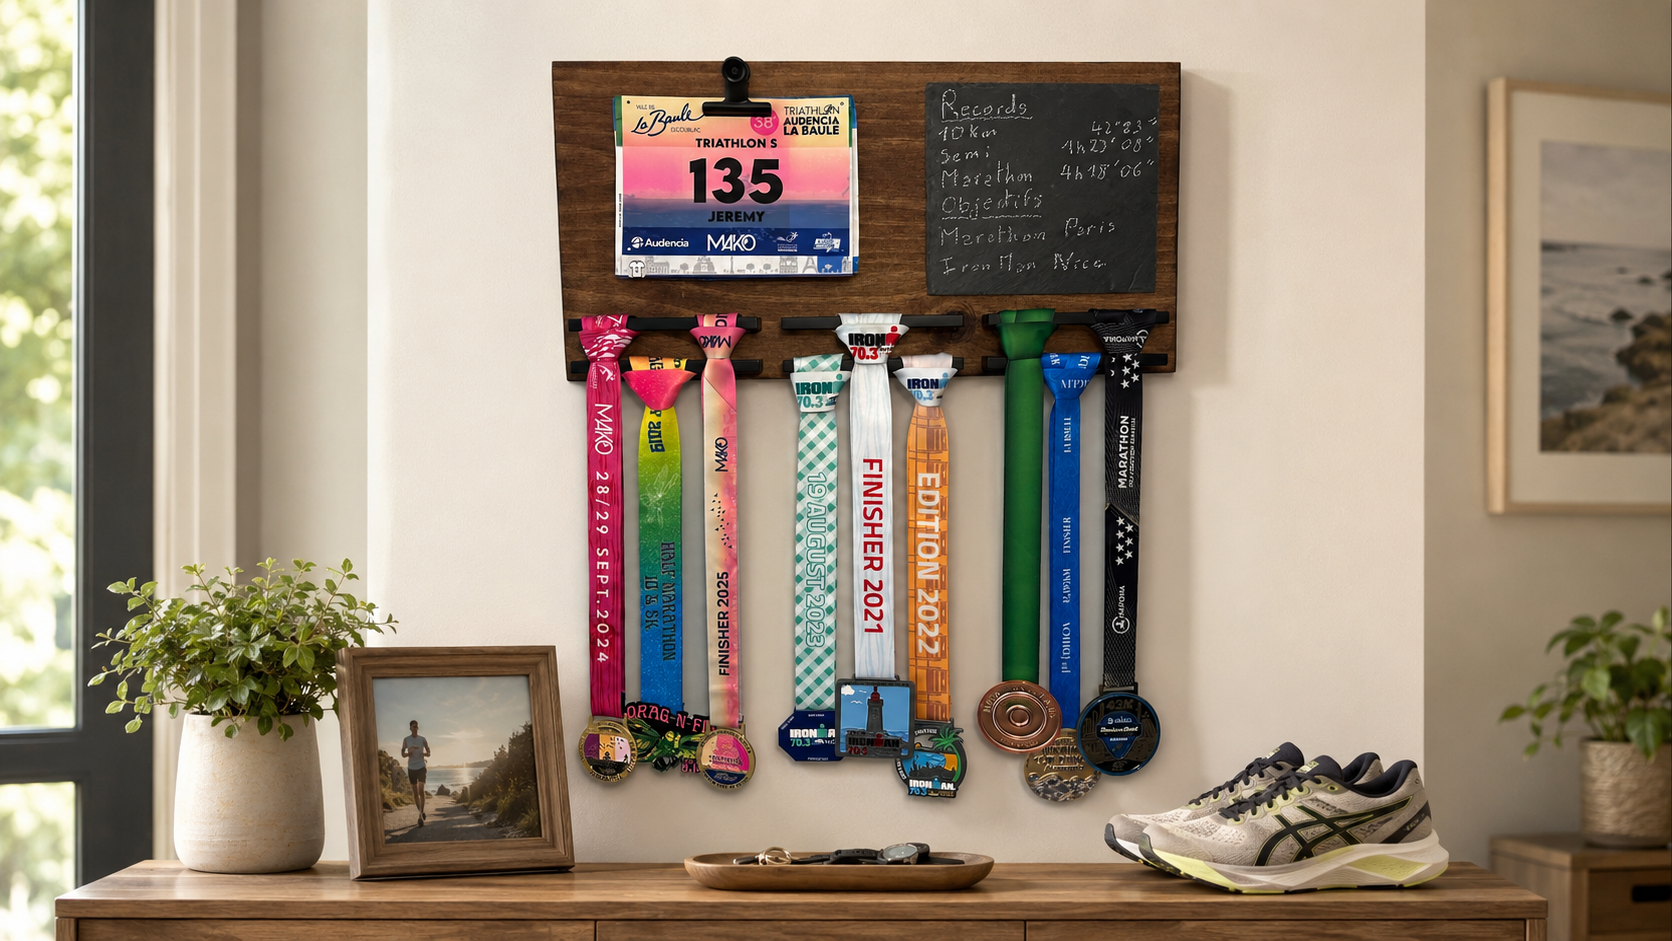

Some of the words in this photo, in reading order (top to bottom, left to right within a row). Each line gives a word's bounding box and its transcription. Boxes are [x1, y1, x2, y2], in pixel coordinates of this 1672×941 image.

[648, 103, 705, 137] Baule
[783, 116, 840, 126] AUDENCIA
[941, 88, 1028, 120] Records
[695, 138, 766, 148] TRIATHLON
[770, 138, 778, 148] S
[783, 126, 799, 136] LA
[801, 126, 840, 136] BAULE
[940, 145, 990, 165] Semi
[689, 157, 783, 204] 135
[941, 160, 1033, 189] Marathon
[708, 210, 766, 223] JEREMY
[1064, 216, 1116, 238] Paris
[644, 238, 690, 248] Audencia
[707, 233, 757, 252] MAKO
[849, 346, 879, 361] 70.3
[594, 403, 614, 455] MAKO
[1117, 415, 1130, 489] MARATHON
[806, 471, 827, 499] 19
[595, 471, 611, 535] 28/29
[862, 458, 884, 572] FINISHER
[916, 472, 940, 581] EDITION
[805, 502, 827, 591] AUGUST
[716, 571, 730, 608] 2025
[863, 579, 884, 634] 2021
[805, 593, 826, 649] 2023
[916, 589, 939, 655] 2022
[718, 612, 730, 677] FINISHER
